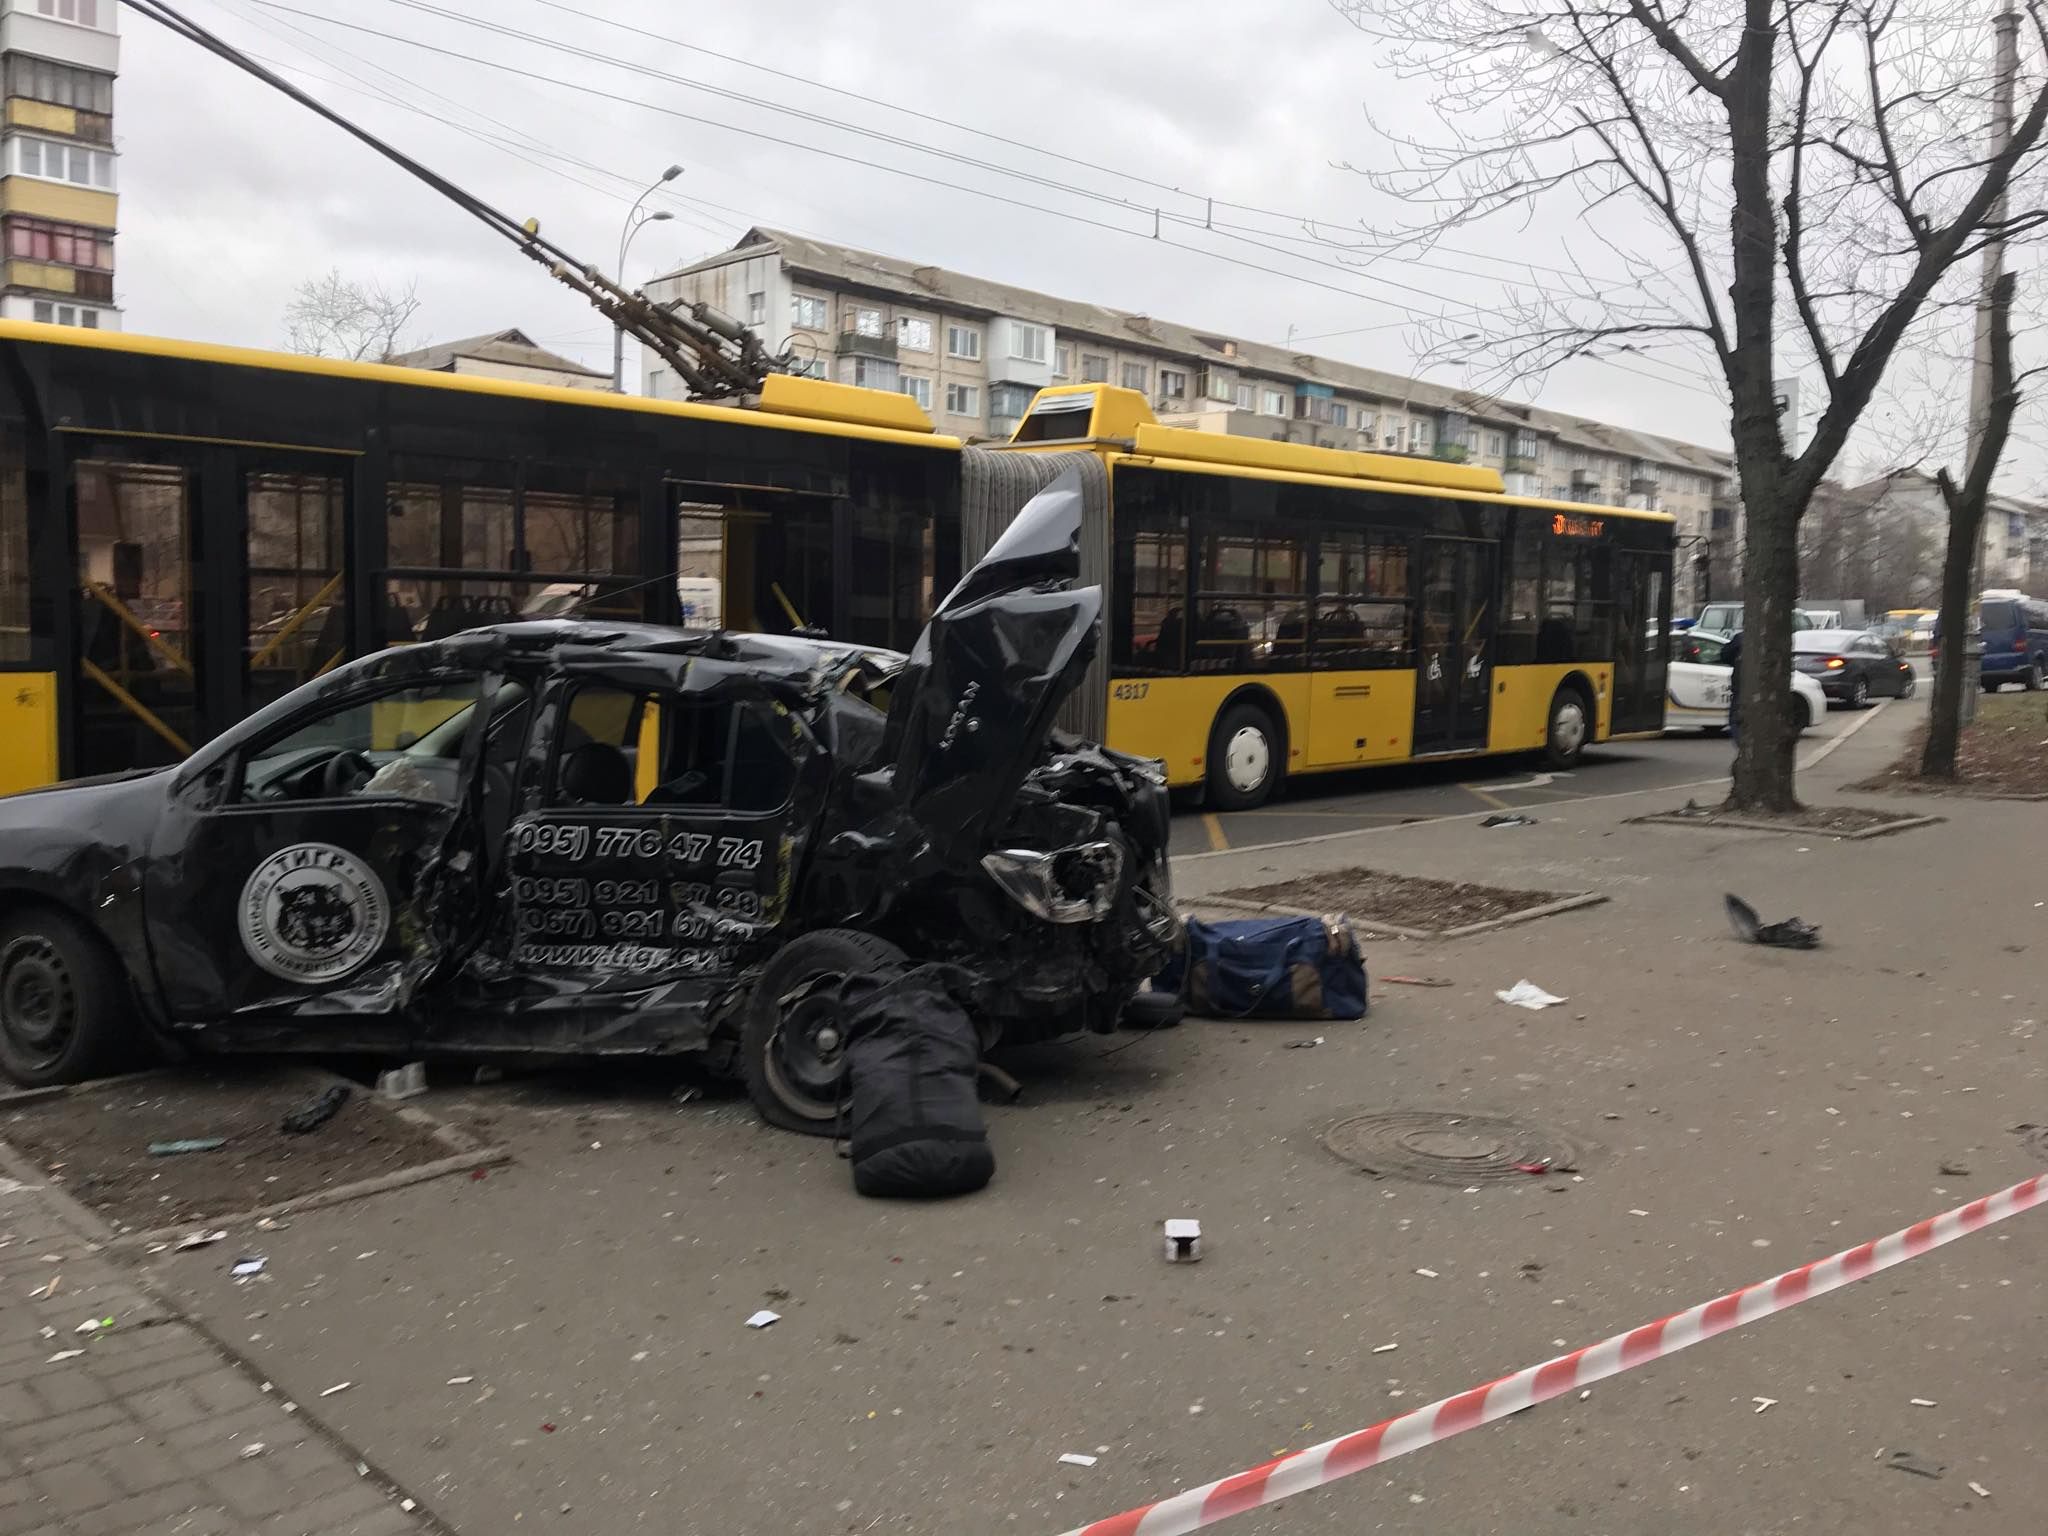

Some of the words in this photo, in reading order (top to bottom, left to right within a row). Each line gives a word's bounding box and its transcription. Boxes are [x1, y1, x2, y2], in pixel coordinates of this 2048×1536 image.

[1114, 682, 1150, 700] 4317
[274, 849, 346, 873] ТИГР
[596, 827, 662, 858] 776
[668, 831, 712, 863] 47
[715, 837, 763, 870] 74
[593, 879, 661, 906] 921
[601, 909, 665, 937] 921
